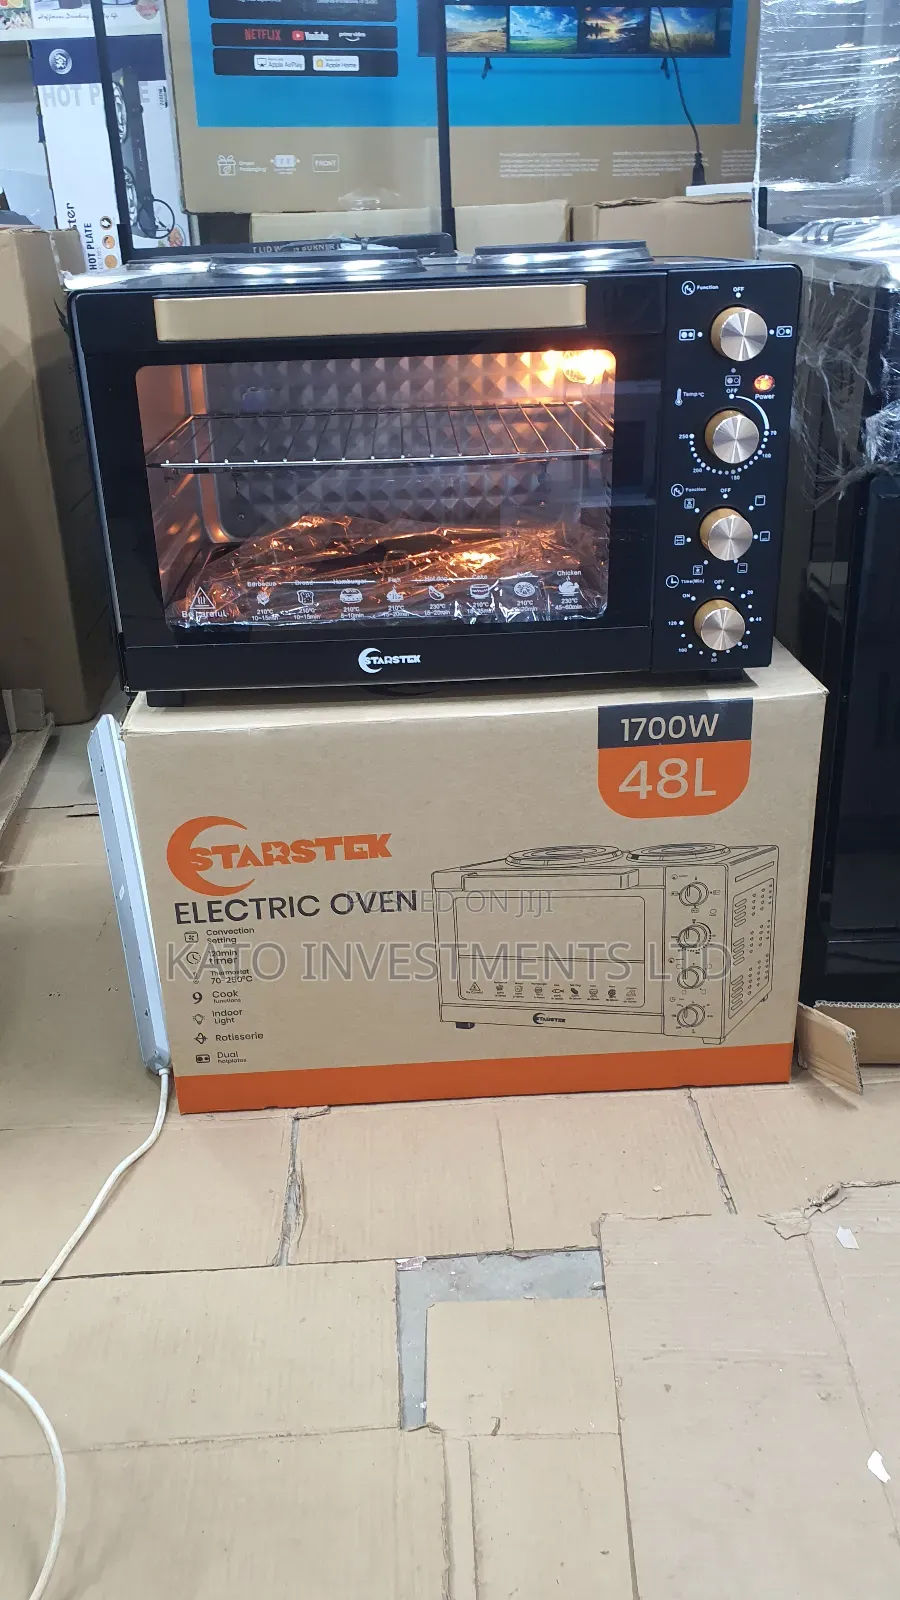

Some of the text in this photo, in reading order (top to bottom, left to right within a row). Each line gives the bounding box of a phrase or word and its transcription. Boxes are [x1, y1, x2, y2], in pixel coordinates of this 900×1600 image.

[244, 28, 281, 41] NETFLIX
[305, 31, 329, 41] YouTube
[268, 61, 303, 69] Apple AirPlay
[41, 85, 82, 107] HOT
[84, 222, 98, 271] HOT PLATE
[259, 246, 272, 254] LID
[620, 713, 720, 742] 1700W
[618, 758, 717, 800] 48L
[189, 833, 392, 872] STARSTEK
[174, 890, 418, 925] ELECTRIC OVEN
[206, 926, 255, 936] Convection
[206, 936, 237, 945] Setting
[208, 957, 238, 965] timer
[192, 992, 203, 1004] 9
[212, 990, 239, 999] Cook
[212, 1008, 243, 1018] Indoor
[214, 1016, 235, 1026] Light
[216, 1032, 264, 1042] Rotisserie
